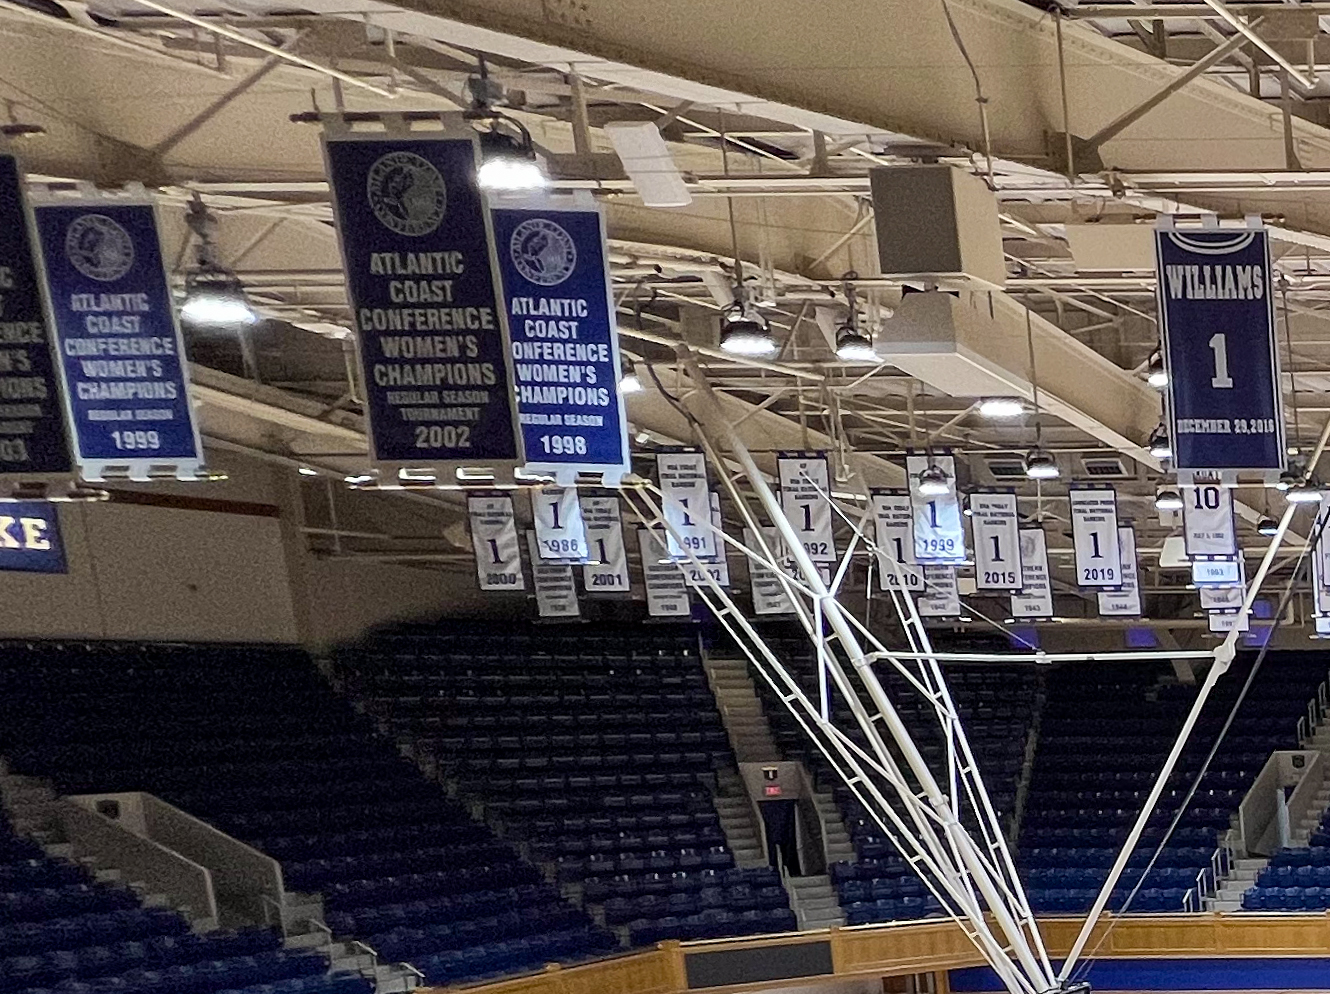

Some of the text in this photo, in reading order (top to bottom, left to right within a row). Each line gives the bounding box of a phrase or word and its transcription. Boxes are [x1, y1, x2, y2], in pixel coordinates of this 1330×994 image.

[370, 252, 464, 275] ATLANTIC
[389, 280, 453, 303] COAST
[1166, 265, 1263, 299] WILLIAMS
[70, 294, 149, 312] ATLANTIC
[512, 298, 588, 317] ATLANTIC
[86, 315, 141, 334] COAST
[361, 307, 497, 331] CONFERENCE
[524, 320, 578, 339] COAST
[65, 337, 175, 356] CONFERENCE
[381, 335, 478, 358] WOMEN'S
[512, 342, 609, 362] ONFERENCE
[81, 360, 162, 378] WOMEN'S
[1208, 333, 1233, 388] 1
[373, 363, 496, 386] CHAMPIONS
[516, 364, 597, 384] WOMEN'S
[77, 382, 177, 400] CHAMPIONS
[443, 391, 489, 405] SEASON
[415, 425, 470, 448] 2002
[1177, 419, 1231, 433] DECEMBER
[111, 431, 160, 450] 1999
[540, 435, 587, 455] 1998
[1193, 486, 1220, 510] 10
[549, 501, 565, 530] 1
[800, 503, 816, 533] 1
[927, 500, 944, 529] 1
[0, 516, 52, 550] KE
[486, 538, 504, 565] 1
[891, 536, 907, 564] 1
[989, 534, 1005, 563] 1
[1089, 531, 1104, 559] 1
[592, 573, 623, 586] 2001
[984, 571, 1016, 584] 2015
[1083, 567, 1115, 581] 2019
